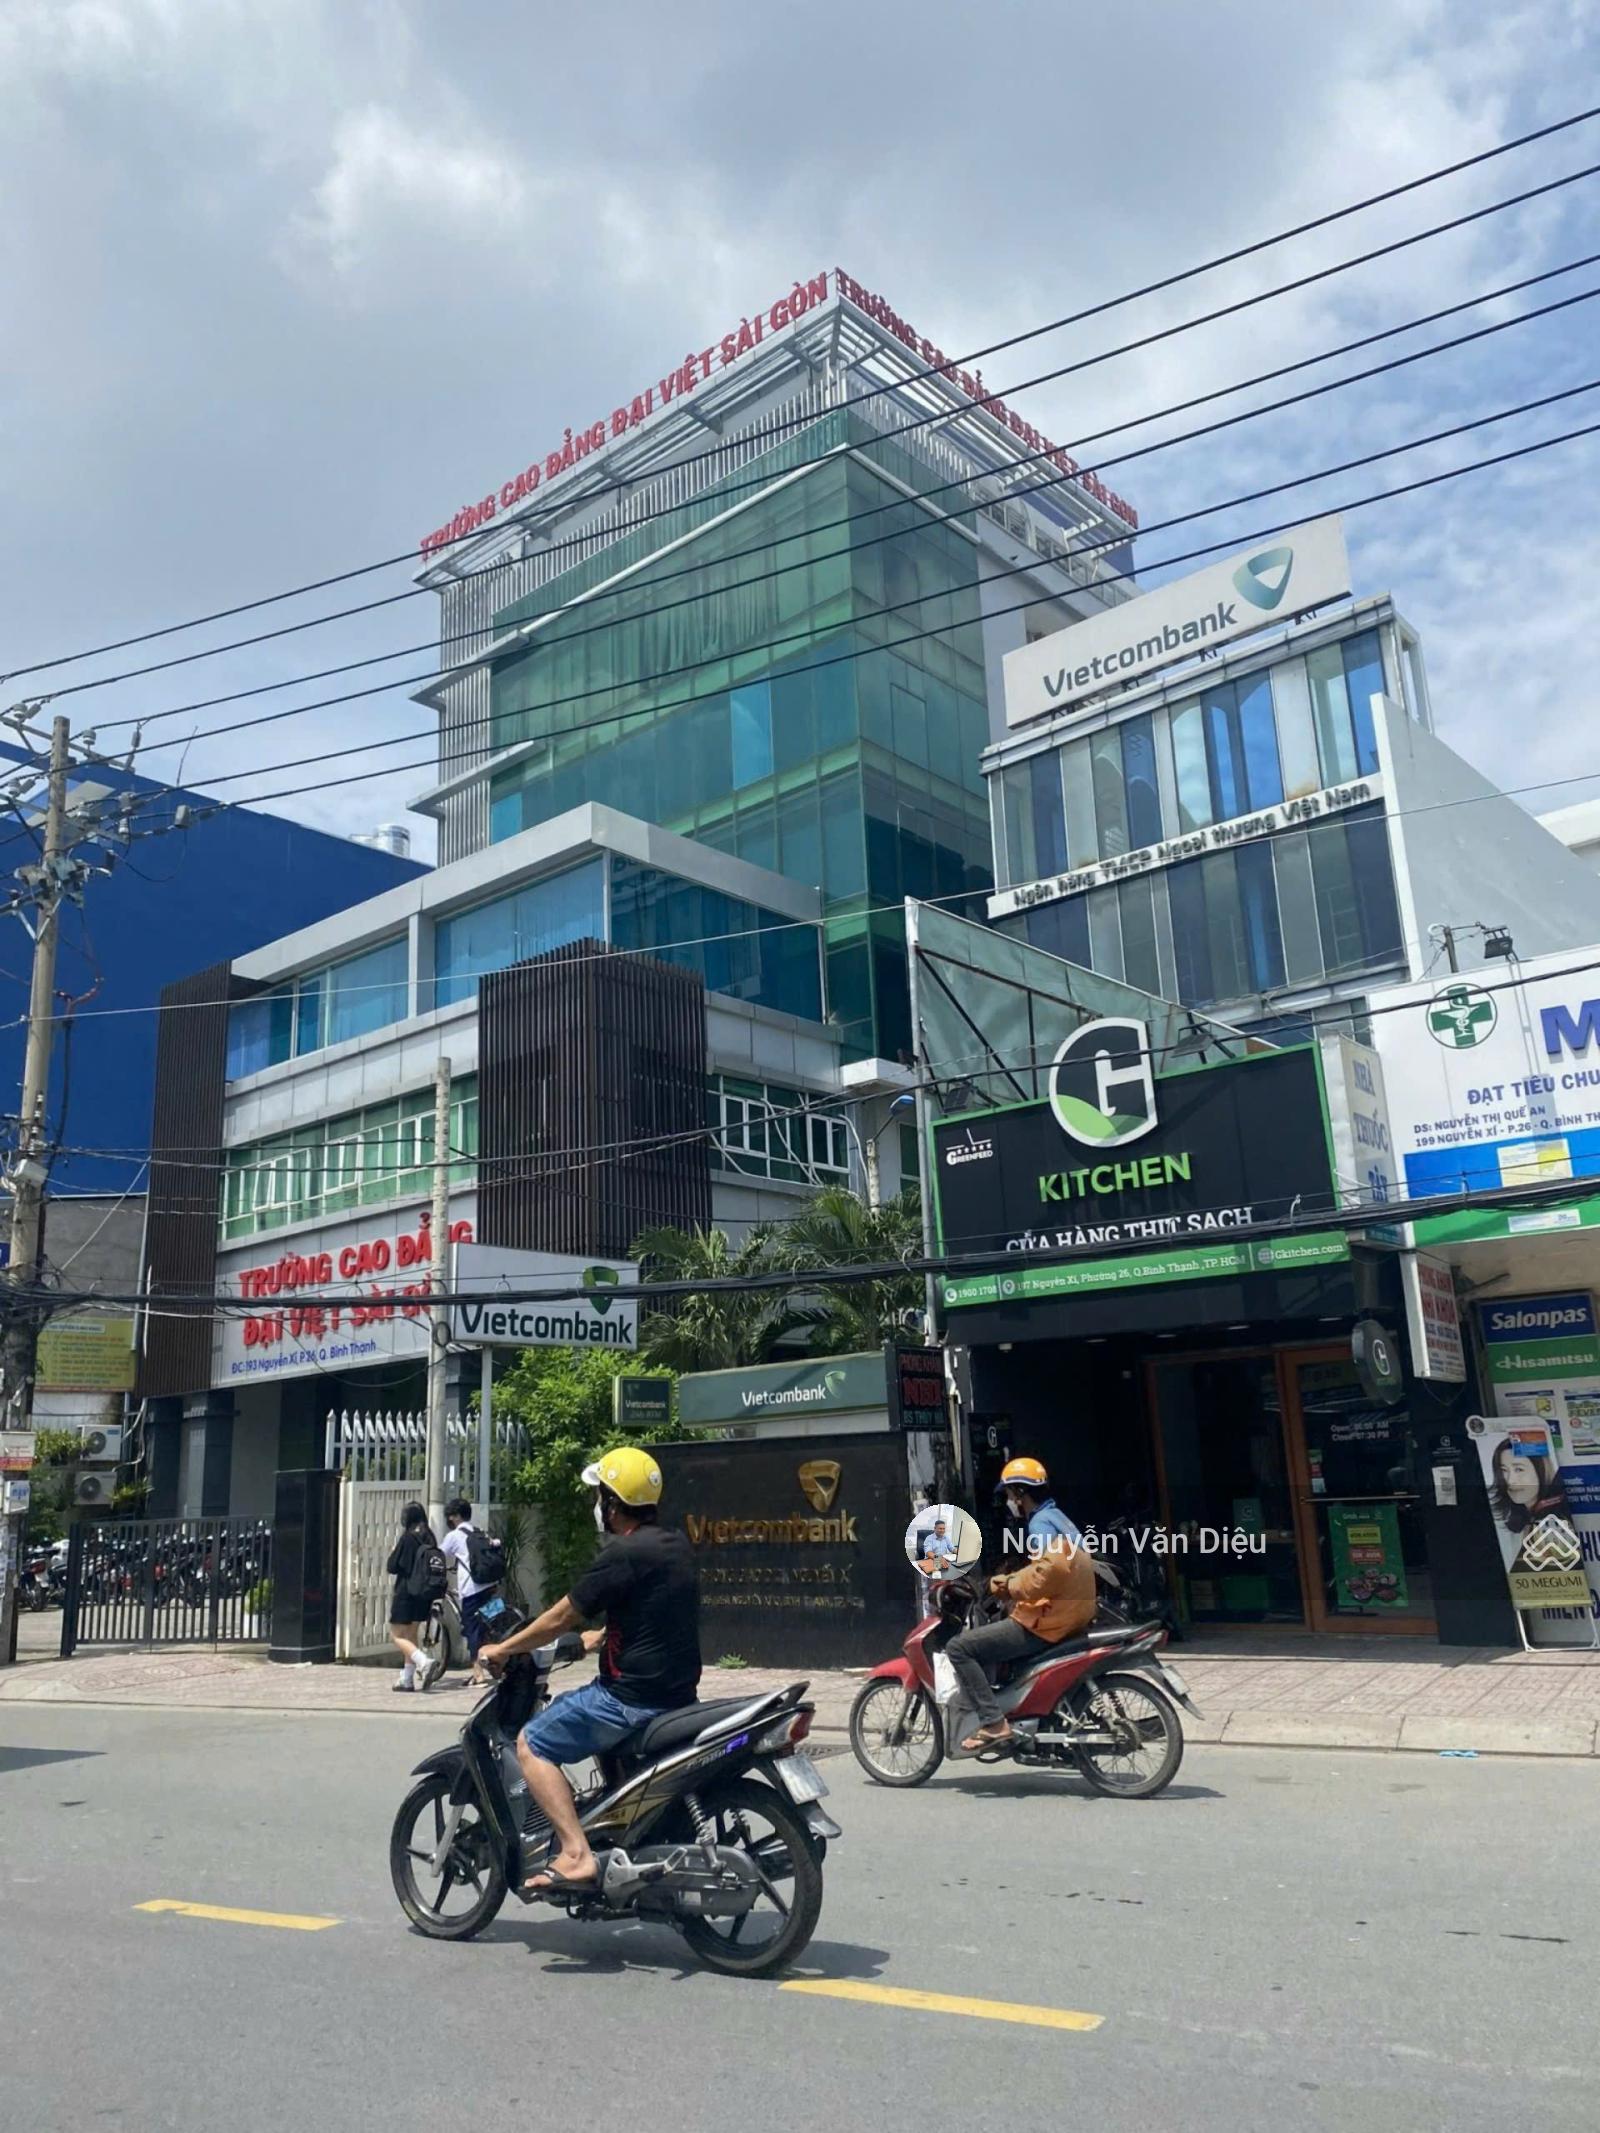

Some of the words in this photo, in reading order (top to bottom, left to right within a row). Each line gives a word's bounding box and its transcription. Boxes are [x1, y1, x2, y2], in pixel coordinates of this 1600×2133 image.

[420, 493, 495, 561] TRƯỜNG
[499, 463, 541, 507] CAO
[611, 388, 653, 437] ĐẠI
[659, 353, 714, 405] VIỆT
[719, 317, 763, 368] SÀI
[769, 271, 828, 332] GÒN
[1043, 601, 1239, 698] Vietcombank
[1013, 884, 1055, 908] Ngân
[1100, 849, 1152, 880] TMCP
[1326, 783, 1370, 808] Nam
[1467, 1084, 1506, 1107] ĐẠT
[1510, 1070, 1556, 1098] TIÊU
[1413, 1122, 1432, 1134] DS:
[1434, 1112, 1479, 1132] NGUYỄN
[1482, 1111, 1501, 1125] THỊ
[1529, 1105, 1546, 1117] AN
[1415, 1136, 1436, 1148] 199
[1437, 1127, 1484, 1146] NGUYỄN
[1486, 1125, 1498, 1138] XÍ
[1507, 1121, 1532, 1134] P.26
[1555, 1113, 1583, 1127] BÌNH
[1040, 1151, 1192, 1203] KITCHEN
[238, 1252, 332, 1299] TRƯỜNG
[338, 1239, 391, 1278] CAO
[396, 1209, 473, 1268] ĐẲG
[1056, 1226, 1120, 1247] HÀNG
[459, 1303, 635, 1346] Vietcombank
[1491, 1307, 1587, 1330] Salonpas
[330, 1344, 349, 1359] Bình
[350, 1338, 377, 1356] Thạnh
[742, 1382, 827, 1408] Vietcombank
[685, 1509, 859, 1546] Vietcombank
[1531, 1575, 1582, 1590] MEGUMI
